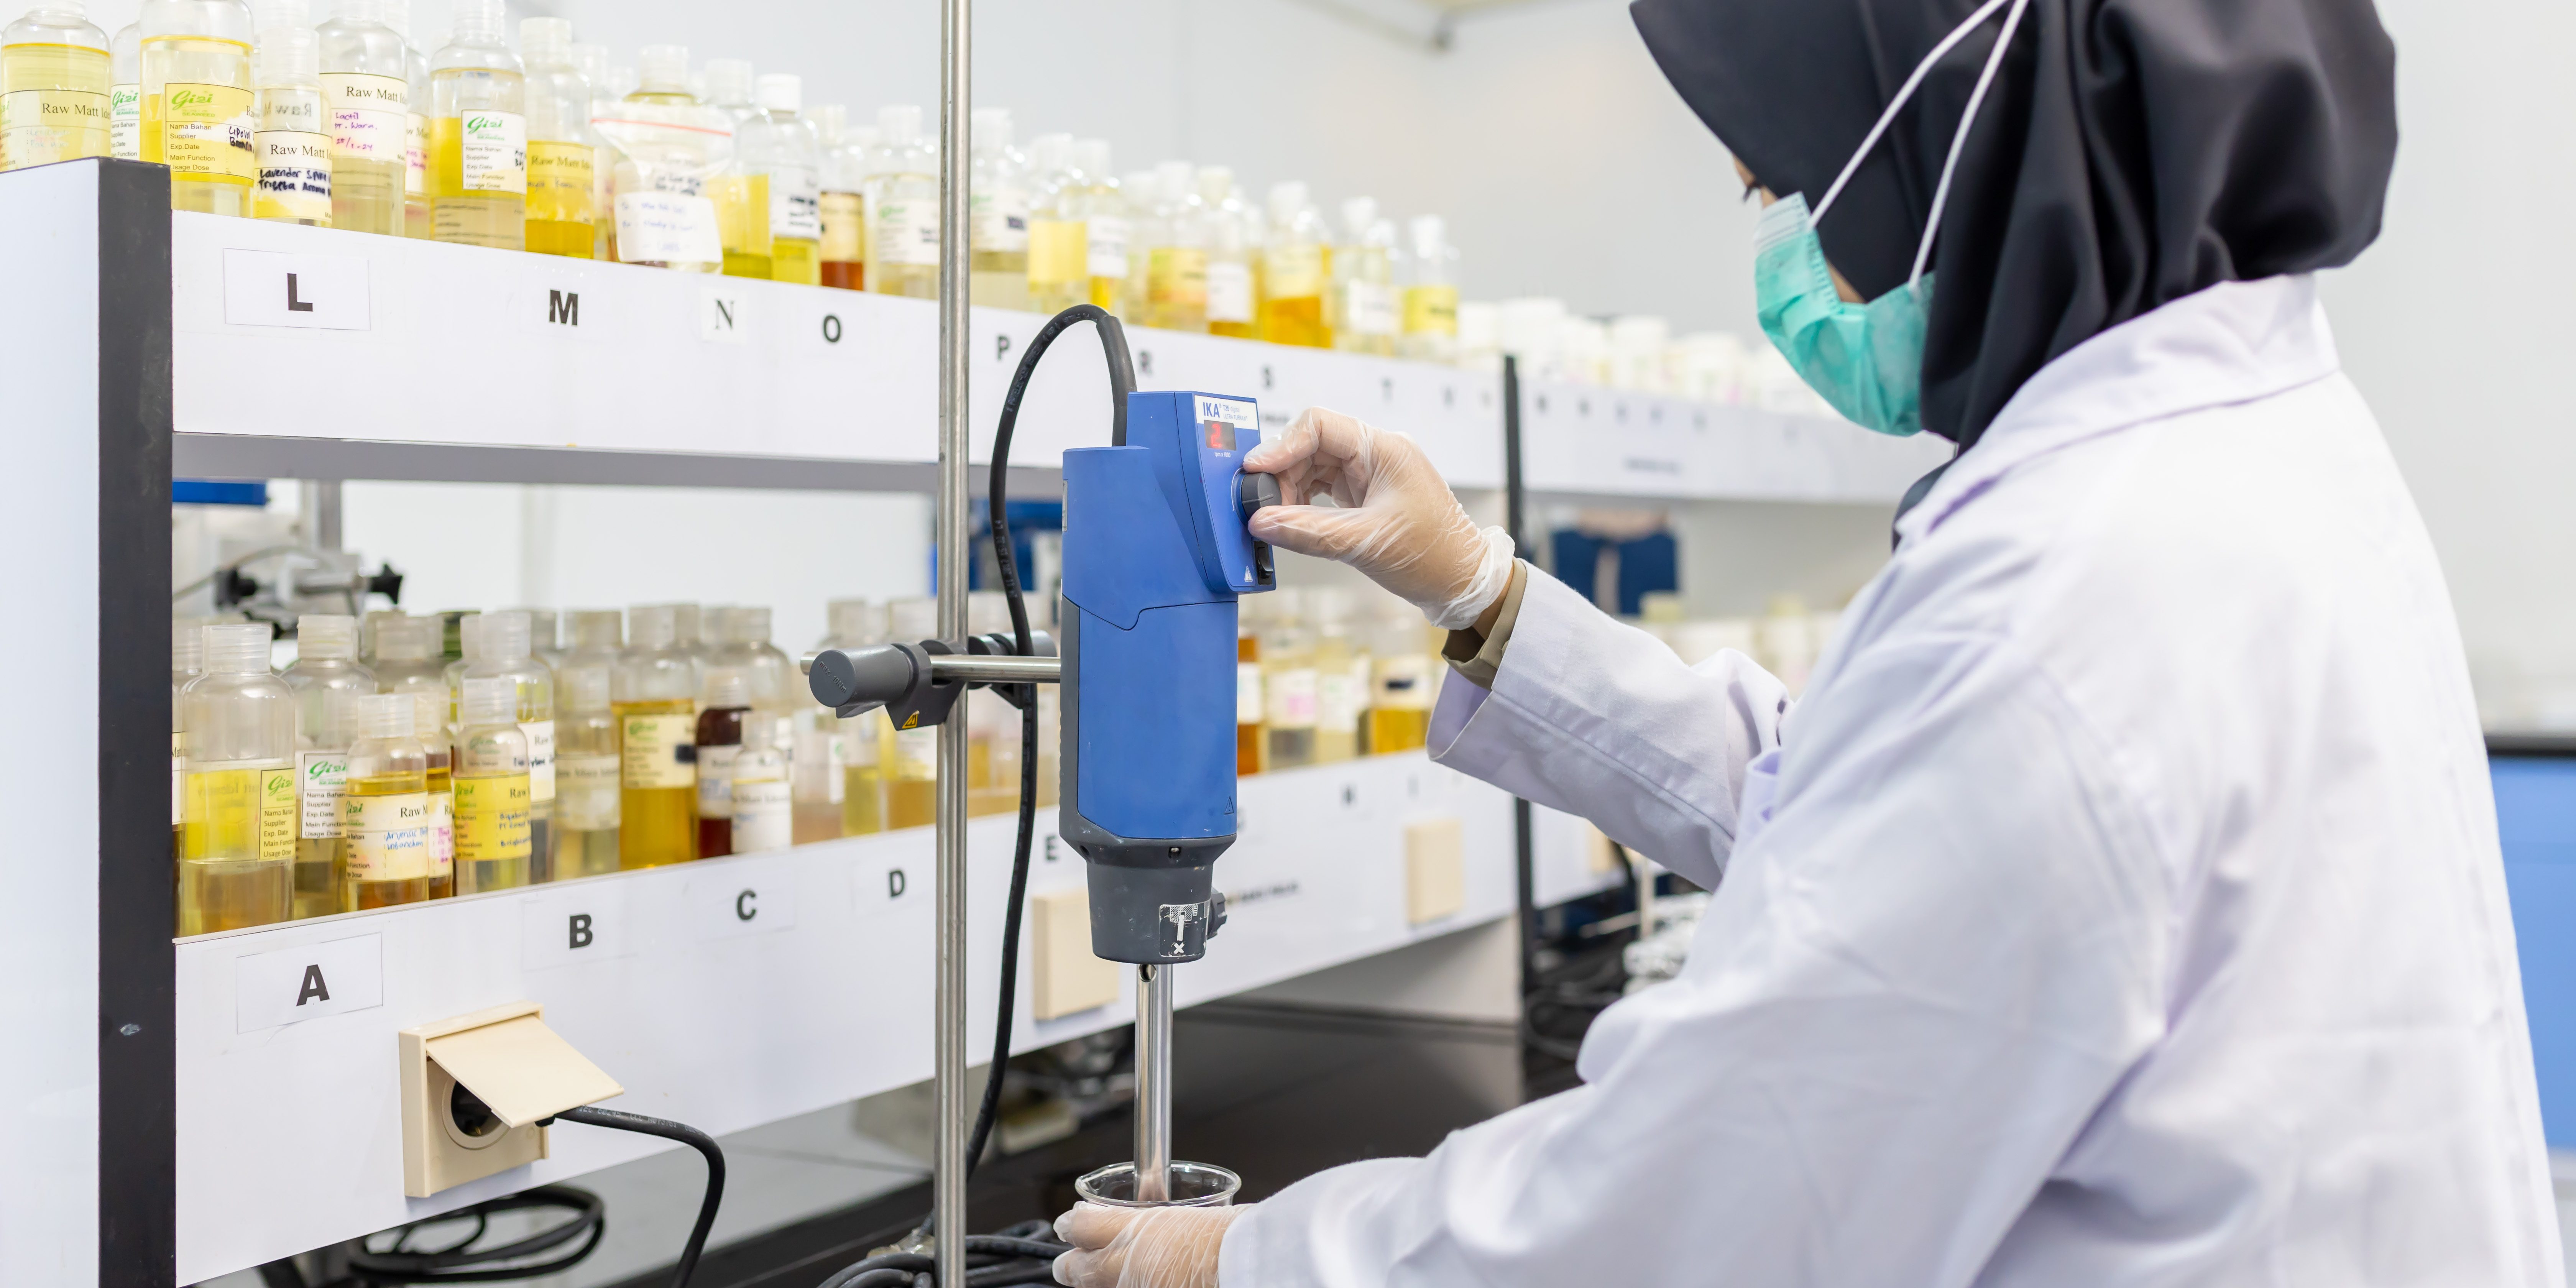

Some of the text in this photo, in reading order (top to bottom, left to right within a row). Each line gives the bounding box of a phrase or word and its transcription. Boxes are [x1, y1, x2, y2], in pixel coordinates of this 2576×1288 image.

[171, 90, 214, 110] Gizi
[347, 86, 372, 98] Raw
[377, 89, 398, 102] Matt
[42, 103, 70, 114] Raw
[75, 104, 98, 117] Matt
[271, 145, 297, 155] Raw
[302, 145, 325, 158] Matt
[287, 273, 313, 312] L
[549, 289, 578, 326] M
[715, 299, 734, 330] N
[823, 315, 842, 343] O
[996, 335, 1010, 360] P
[833, 675, 846, 693] 10Nm
[401, 807, 421, 818] Raw
[1045, 835, 1059, 861] E
[889, 870, 905, 897] D
[736, 890, 757, 922] C
[569, 914, 593, 949] B
[296, 964, 330, 1007] A
